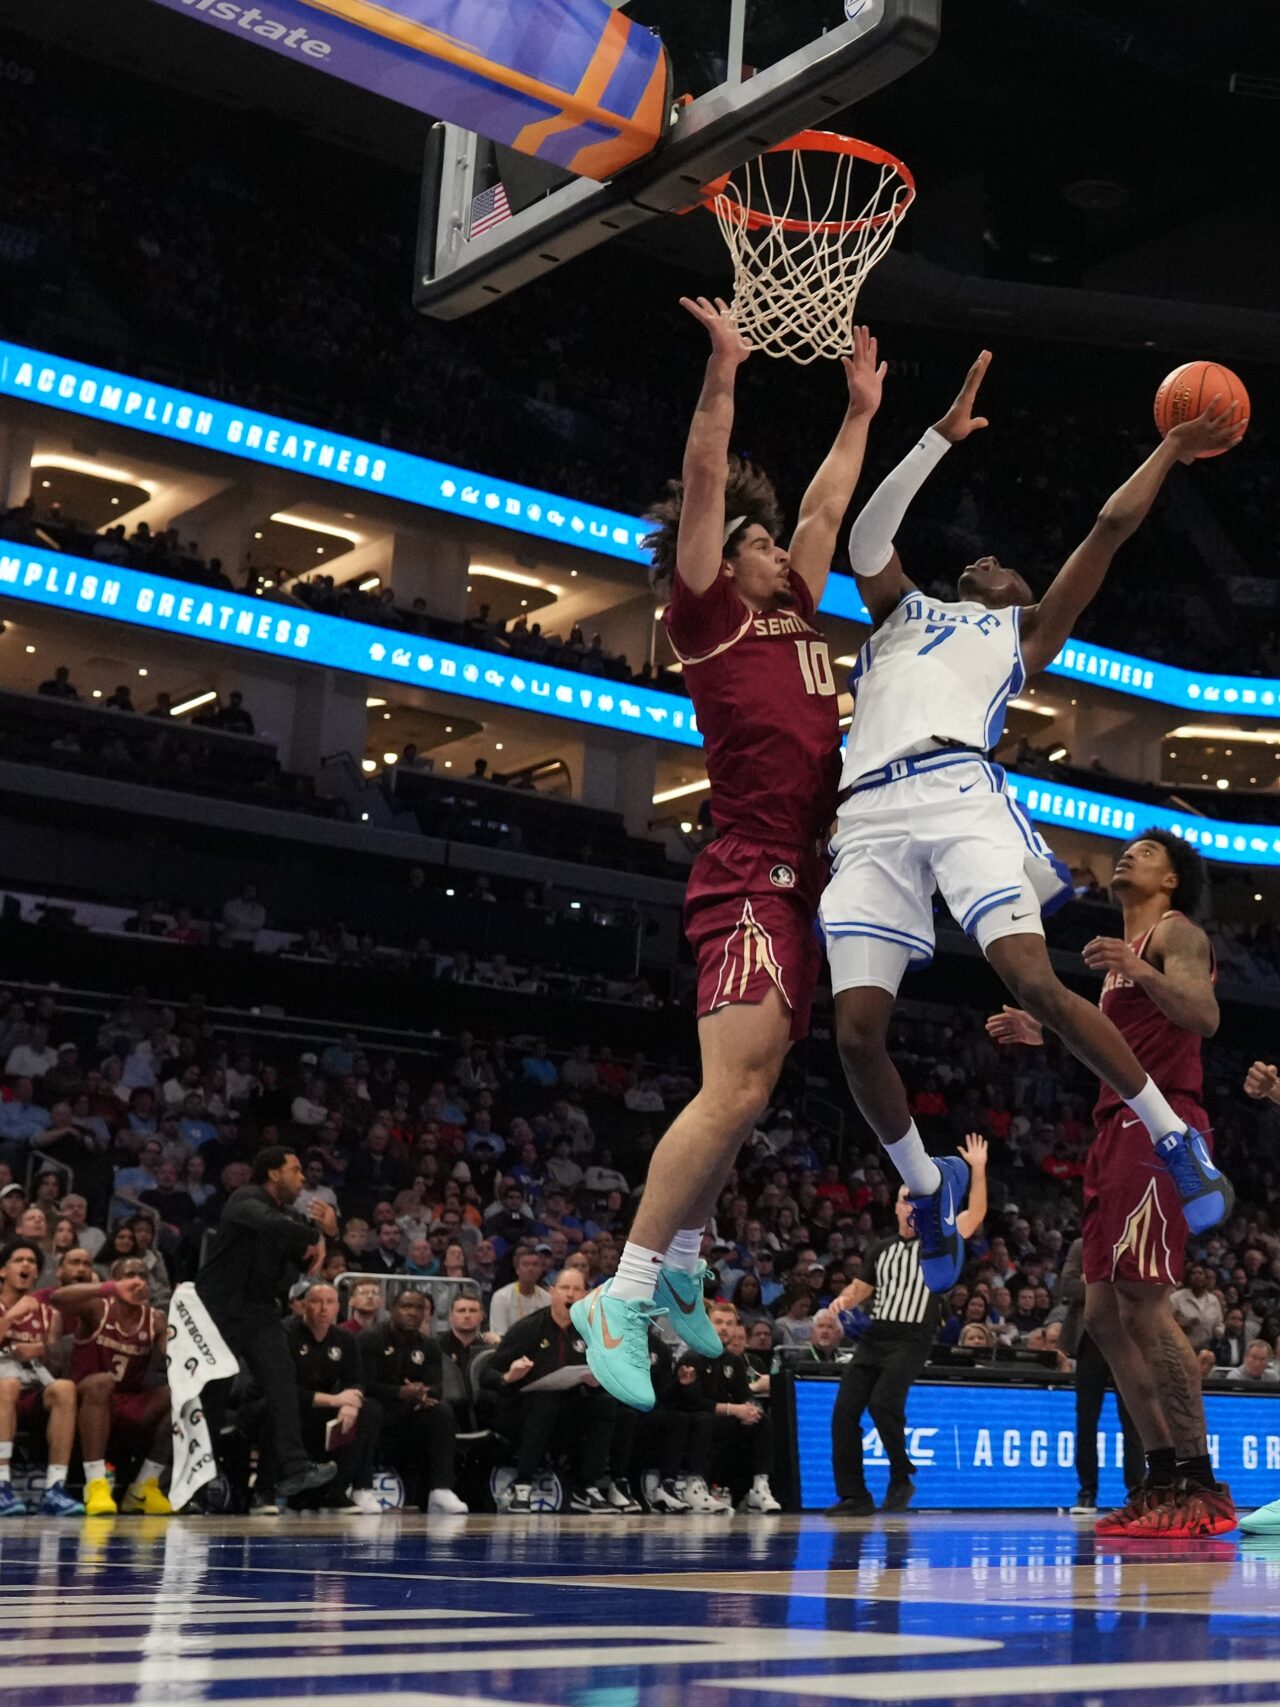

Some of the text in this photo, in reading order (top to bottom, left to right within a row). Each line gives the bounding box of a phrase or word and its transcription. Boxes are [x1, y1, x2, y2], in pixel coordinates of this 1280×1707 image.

[15, 362, 387, 482] ACCOMPLISH GREATNESS
[136, 587, 311, 648] GREATNESS
[917, 624, 957, 656] 7
[794, 640, 836, 696] 10
[1027, 790, 1135, 832] GREATNESS
[178, 1299, 217, 1367] GATORADE
[111, 1354, 130, 1382] 3
